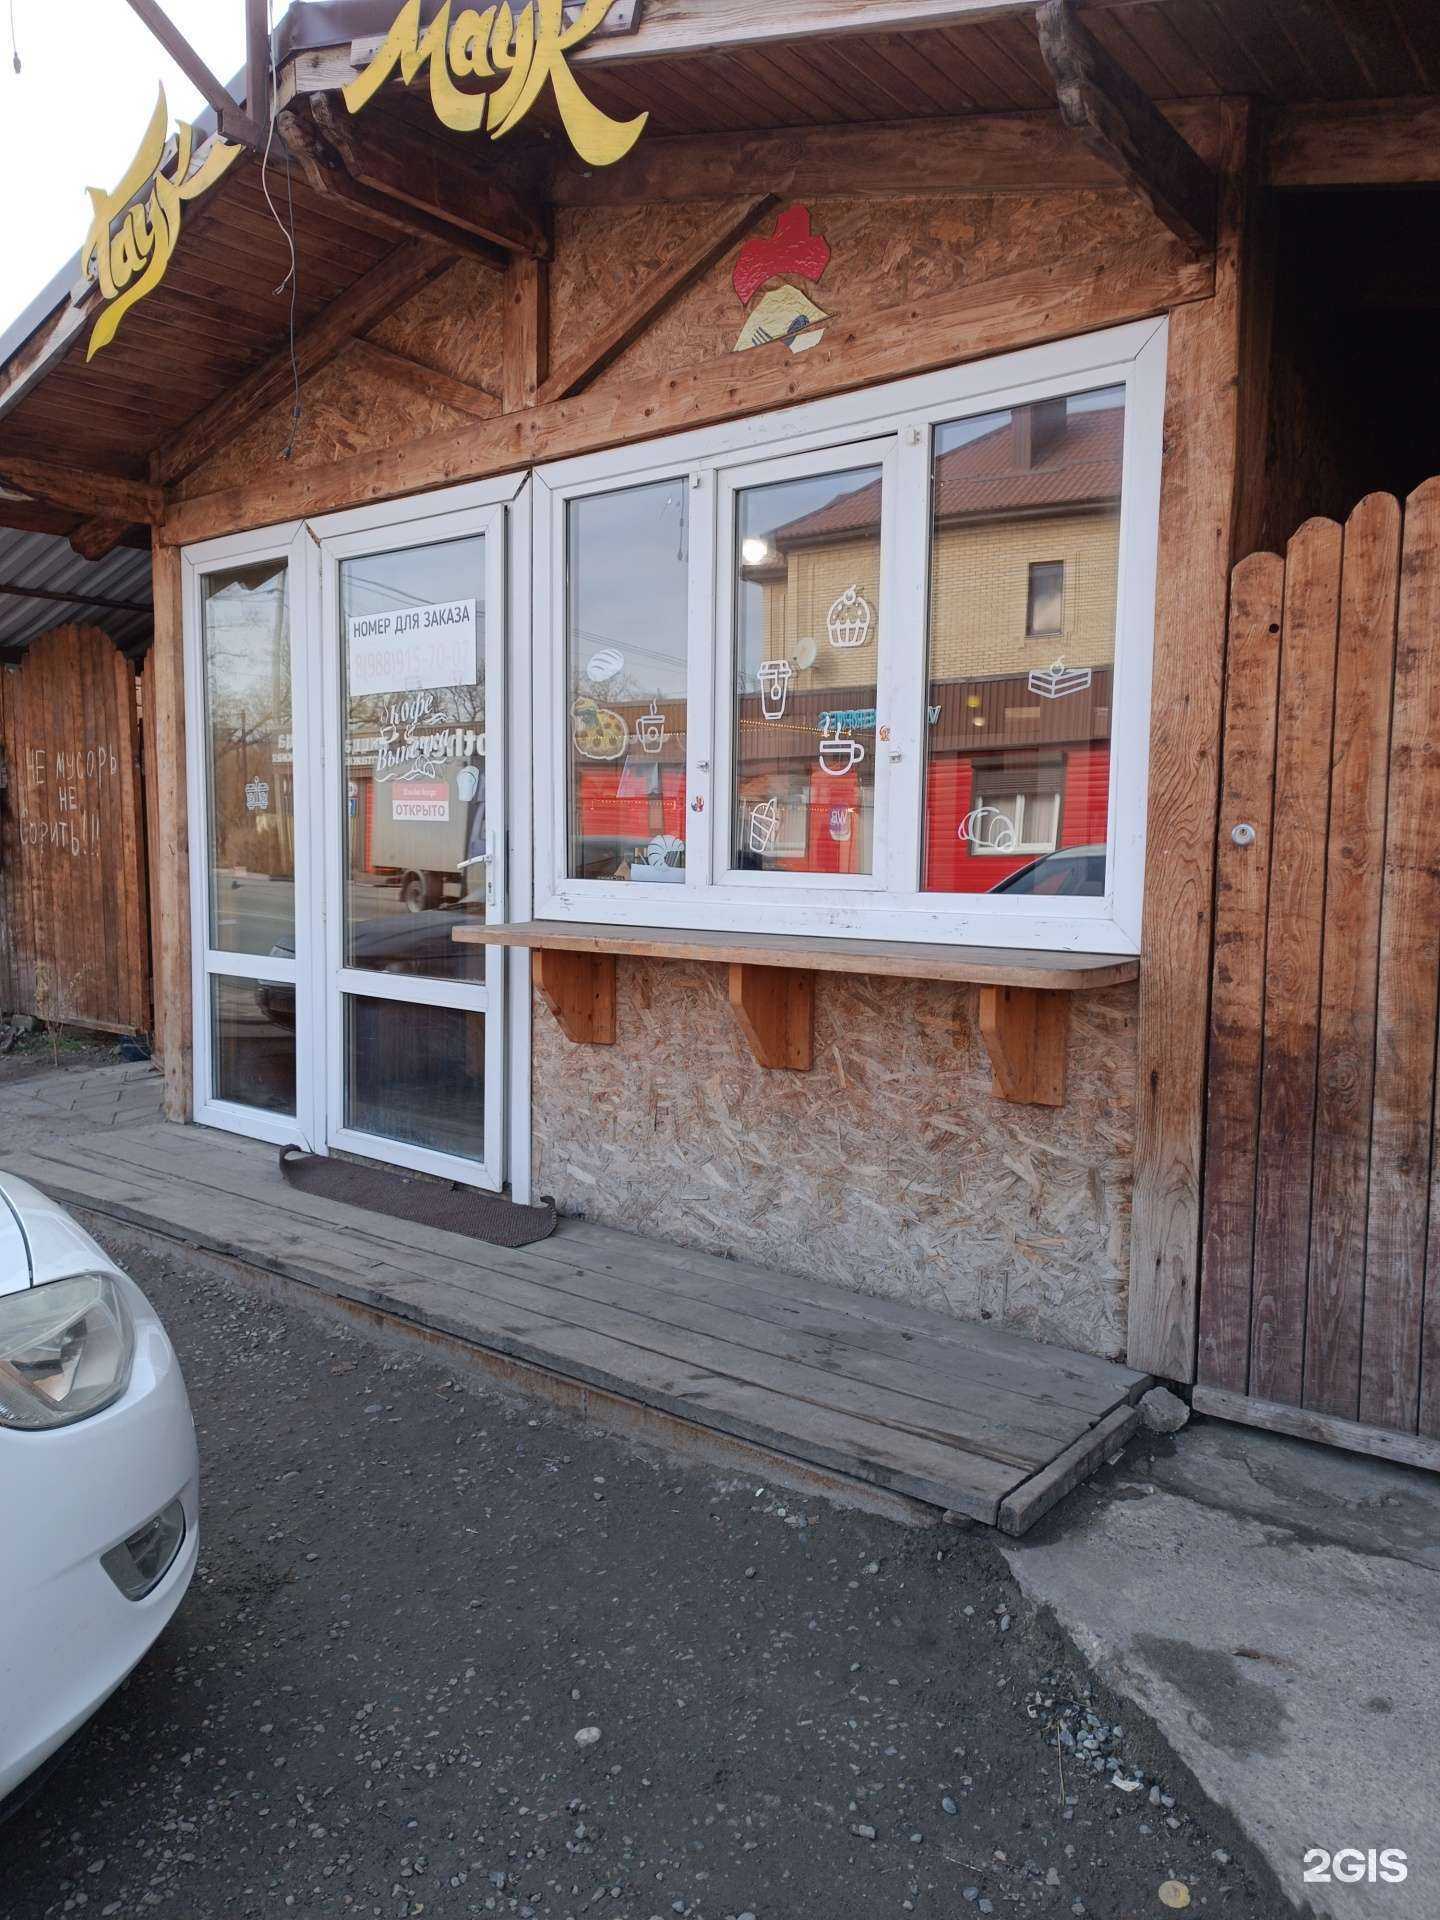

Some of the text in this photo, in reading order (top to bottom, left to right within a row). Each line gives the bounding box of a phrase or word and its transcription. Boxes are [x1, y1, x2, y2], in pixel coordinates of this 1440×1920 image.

[354, 605, 470, 638] НОМЕР ДЛЯ ЗАКАЗА
[26, 743, 117, 790] НЕ МУСОРЬ
[59, 786, 78, 812] НЕ
[395, 804, 446, 817] ОТКРЫТО
